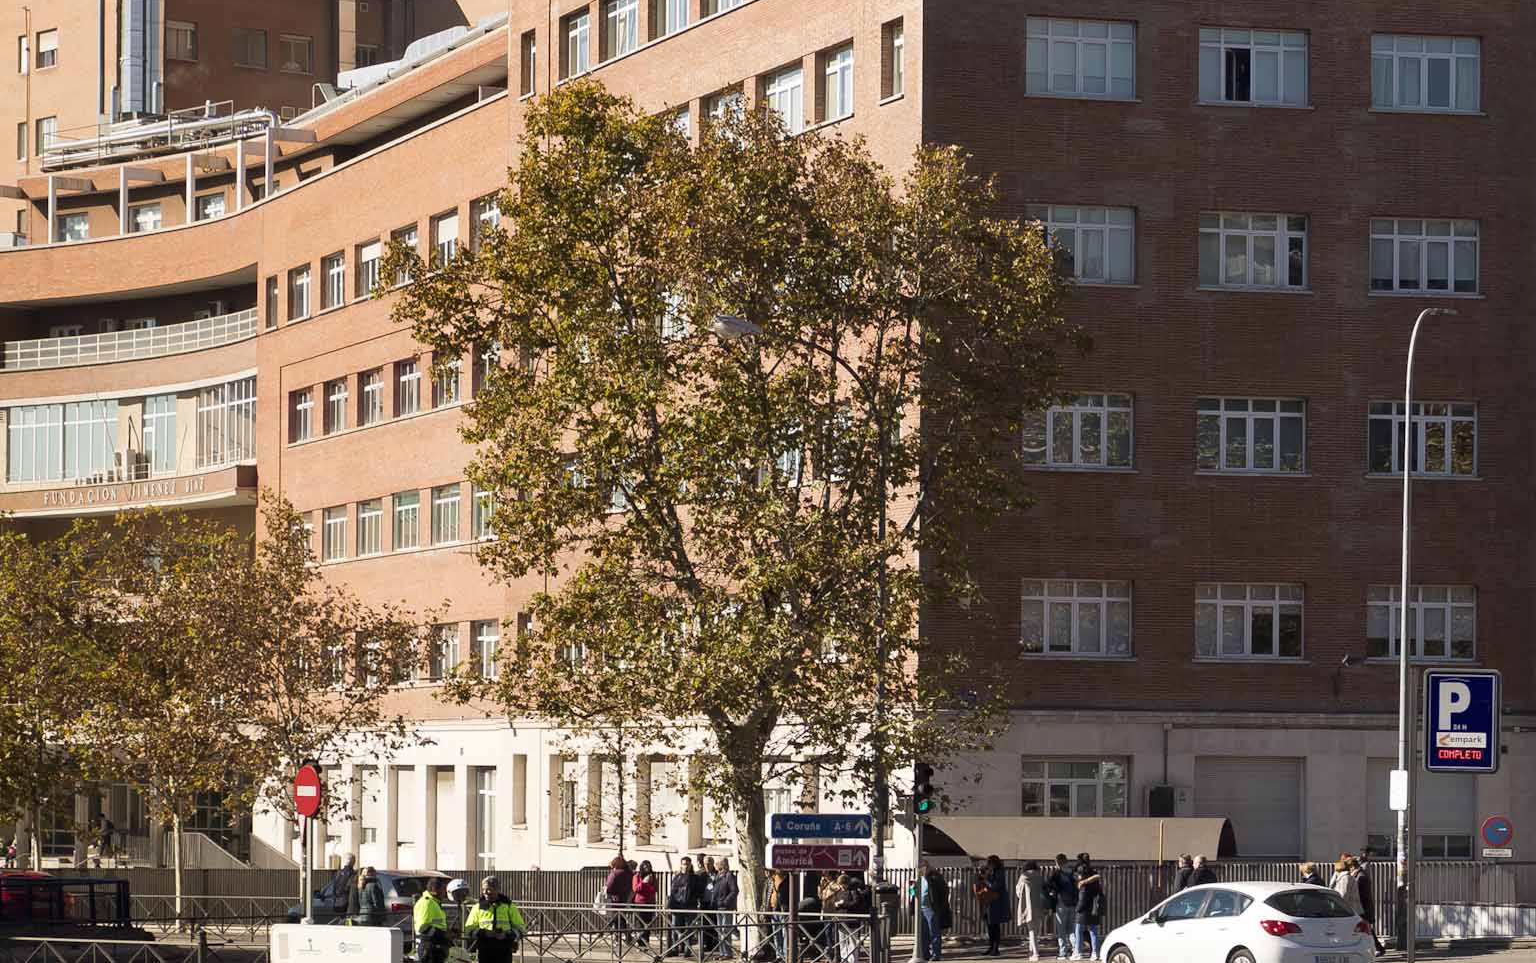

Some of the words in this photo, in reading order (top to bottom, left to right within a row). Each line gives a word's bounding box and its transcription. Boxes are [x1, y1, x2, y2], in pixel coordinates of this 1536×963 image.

[43, 488, 118, 506] FUNDACION
[1438, 682, 1472, 731] P
[1450, 735, 1483, 744] empark
[1438, 749, 1482, 760] COMPLETO
[775, 822, 782, 830] A
